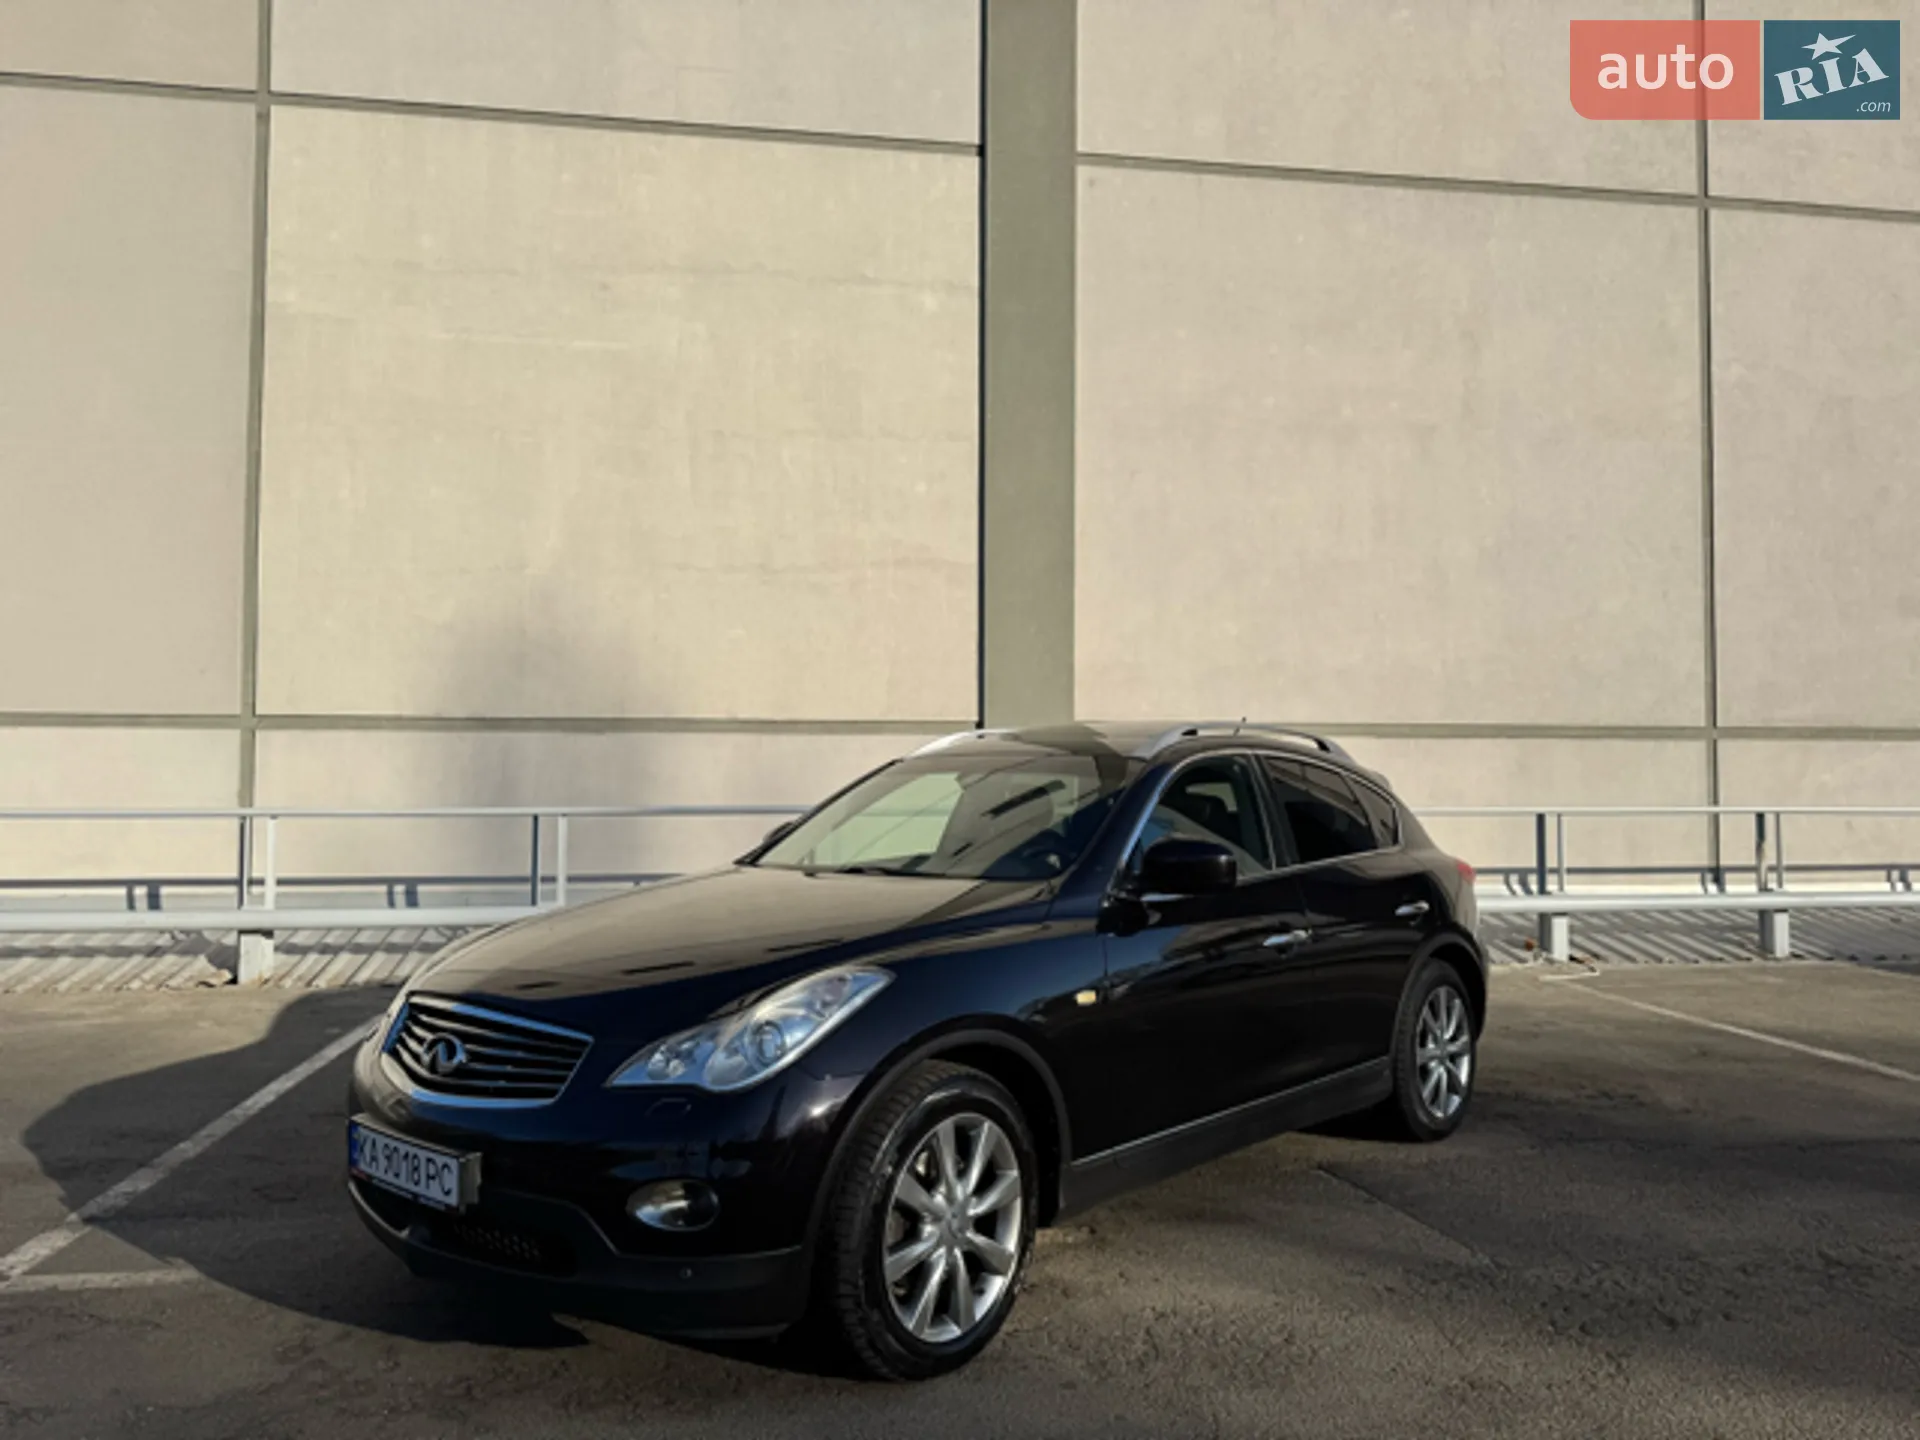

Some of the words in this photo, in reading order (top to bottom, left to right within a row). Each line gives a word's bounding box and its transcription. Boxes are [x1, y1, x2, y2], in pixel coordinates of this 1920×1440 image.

[359, 1133, 379, 1172] KA
[382, 1143, 421, 1186] 9018
[425, 1157, 454, 1197] PC
